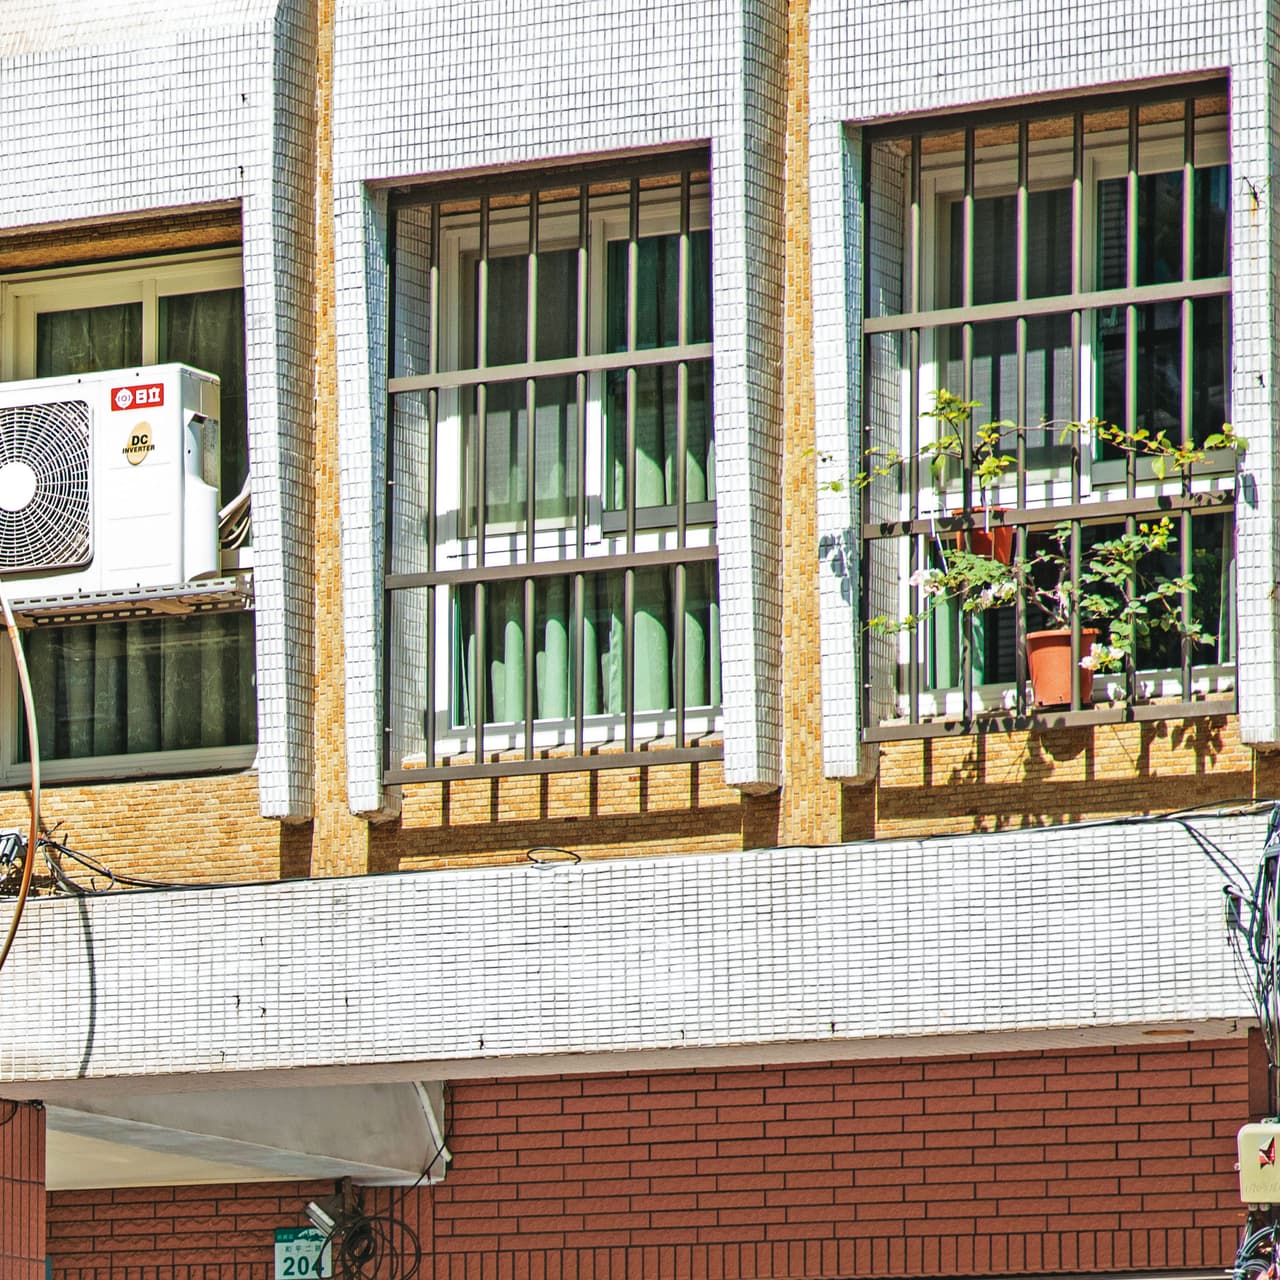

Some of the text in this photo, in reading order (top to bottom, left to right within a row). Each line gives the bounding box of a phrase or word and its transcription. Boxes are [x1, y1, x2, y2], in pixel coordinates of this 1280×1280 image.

[135, 387, 161, 404] 日立
[131, 434, 149, 445] DC
[122, 444, 155, 454] INVERTER
